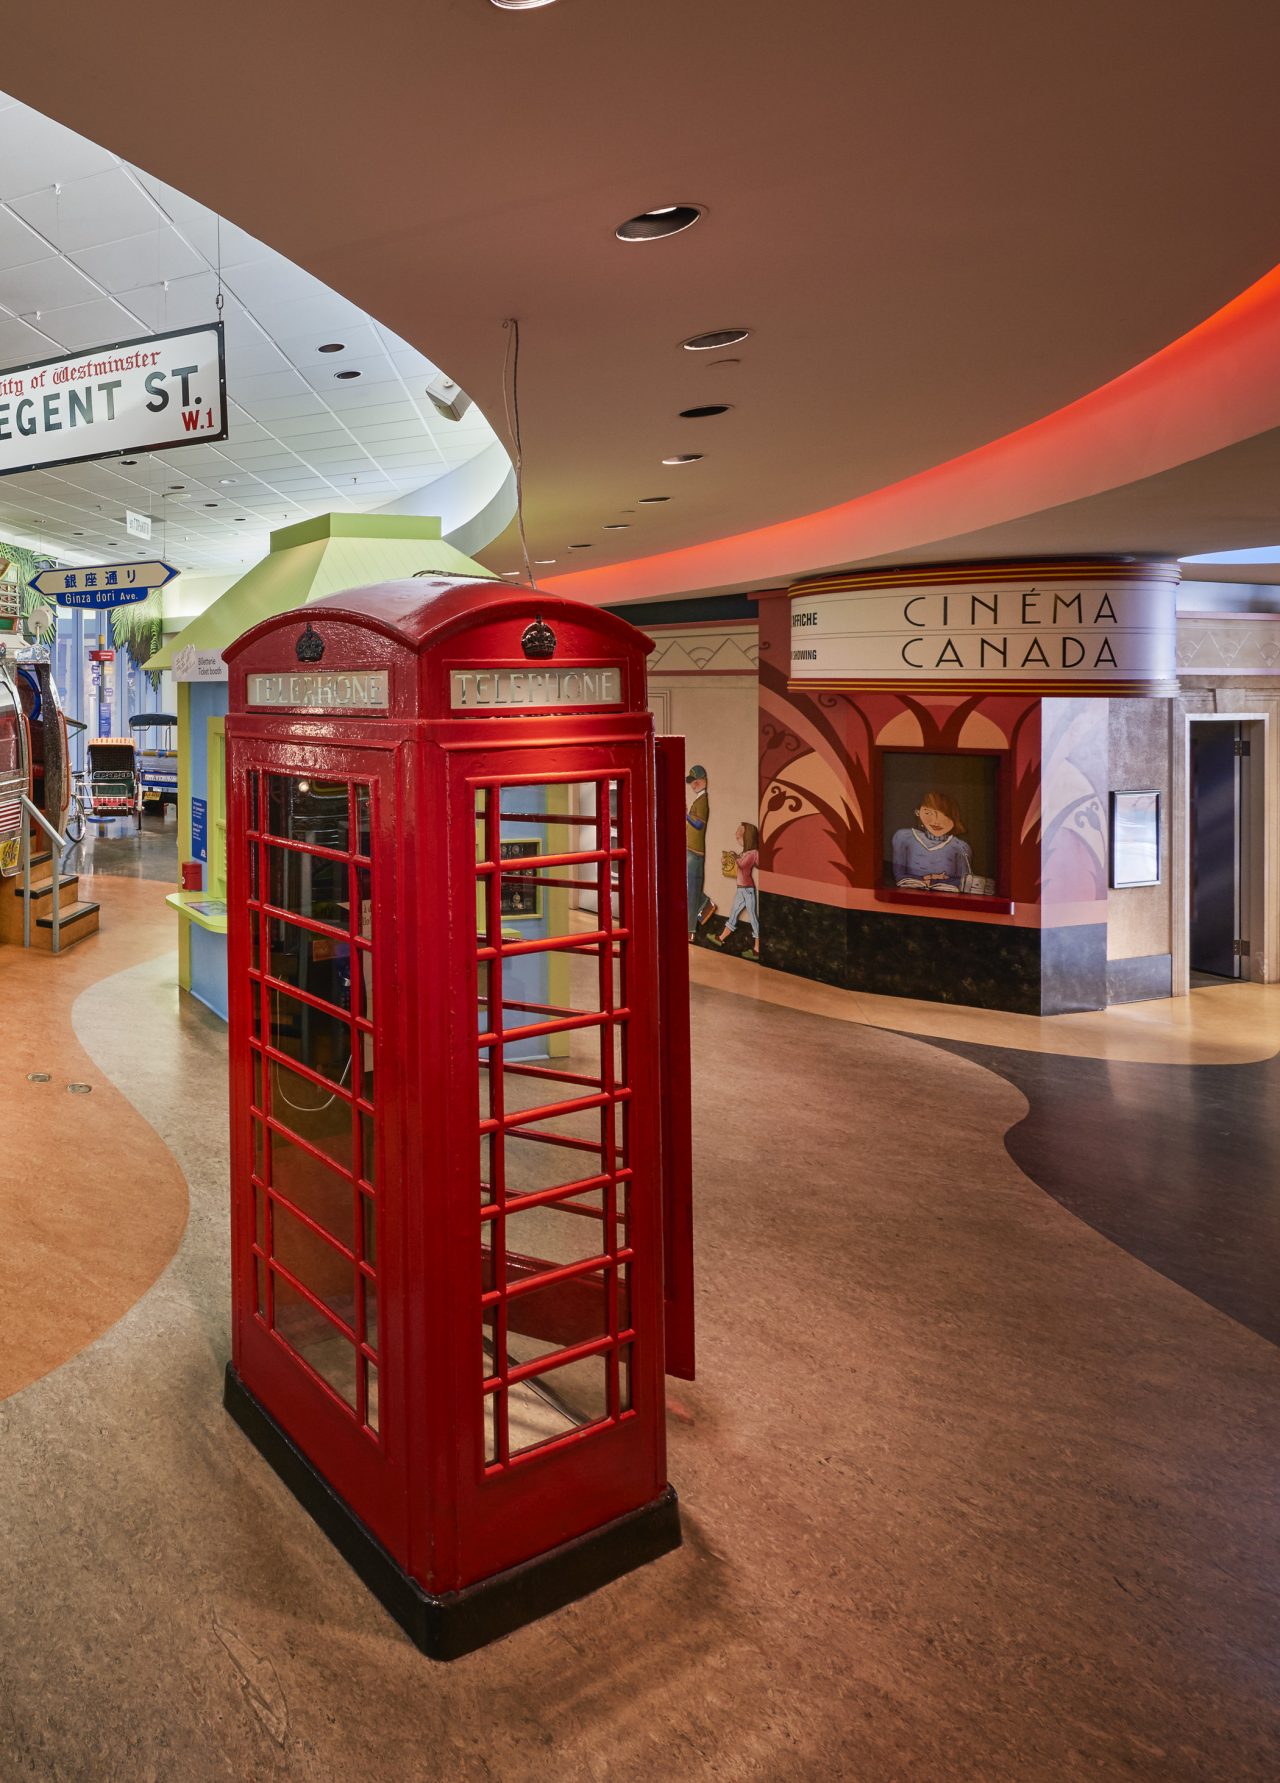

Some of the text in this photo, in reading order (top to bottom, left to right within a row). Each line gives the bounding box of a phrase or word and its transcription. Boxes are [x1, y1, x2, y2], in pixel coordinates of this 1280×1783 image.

[30, 370, 47, 389] of
[53, 350, 161, 385] Westminster
[144, 365, 202, 413] ST.
[181, 407, 215, 432] W.1
[65, 591, 138, 604] Ginza dori Ave.
[903, 588, 1118, 627] CINÉMA
[901, 636, 1118, 669] CANADA
[254, 675, 385, 706] TELEPHONE
[455, 671, 614, 706] TELEPHONE
